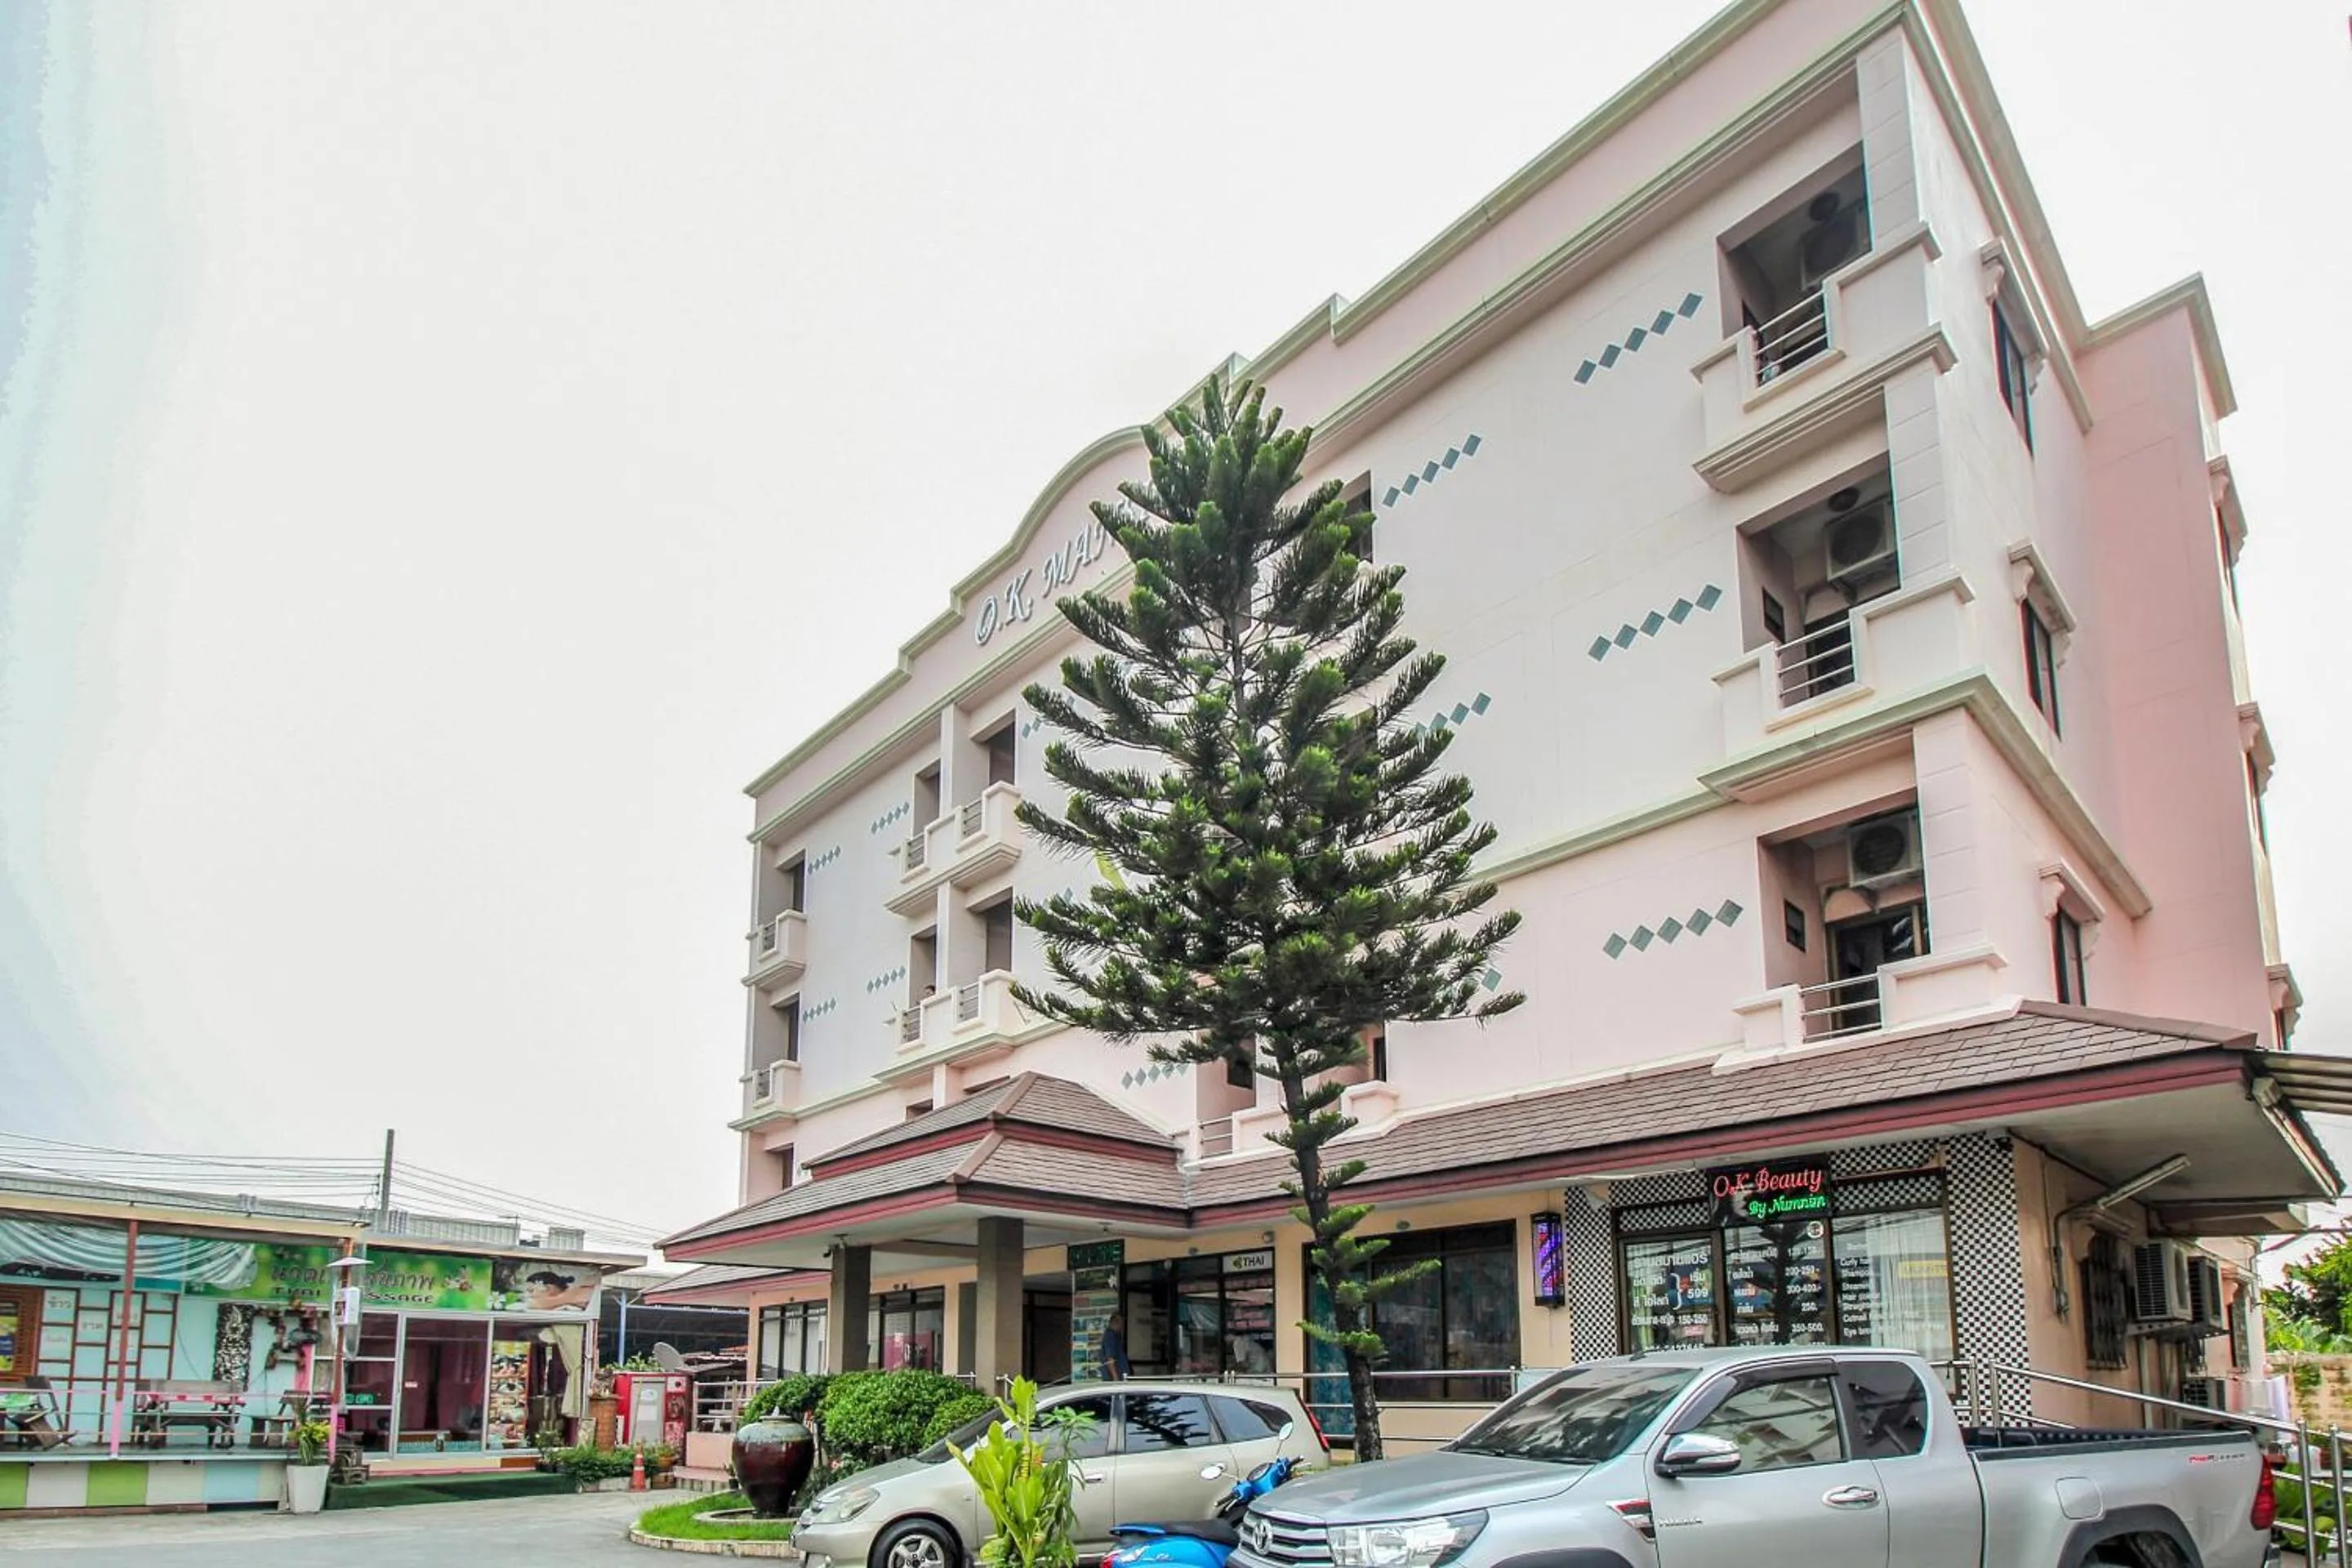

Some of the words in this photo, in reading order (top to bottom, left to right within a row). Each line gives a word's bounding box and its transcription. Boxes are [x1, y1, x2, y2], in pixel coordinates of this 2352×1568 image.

[1755, 1166, 1822, 1193] Beauty
[1748, 1200, 1766, 1218] By
[1243, 1254, 1265, 1267] THAI
